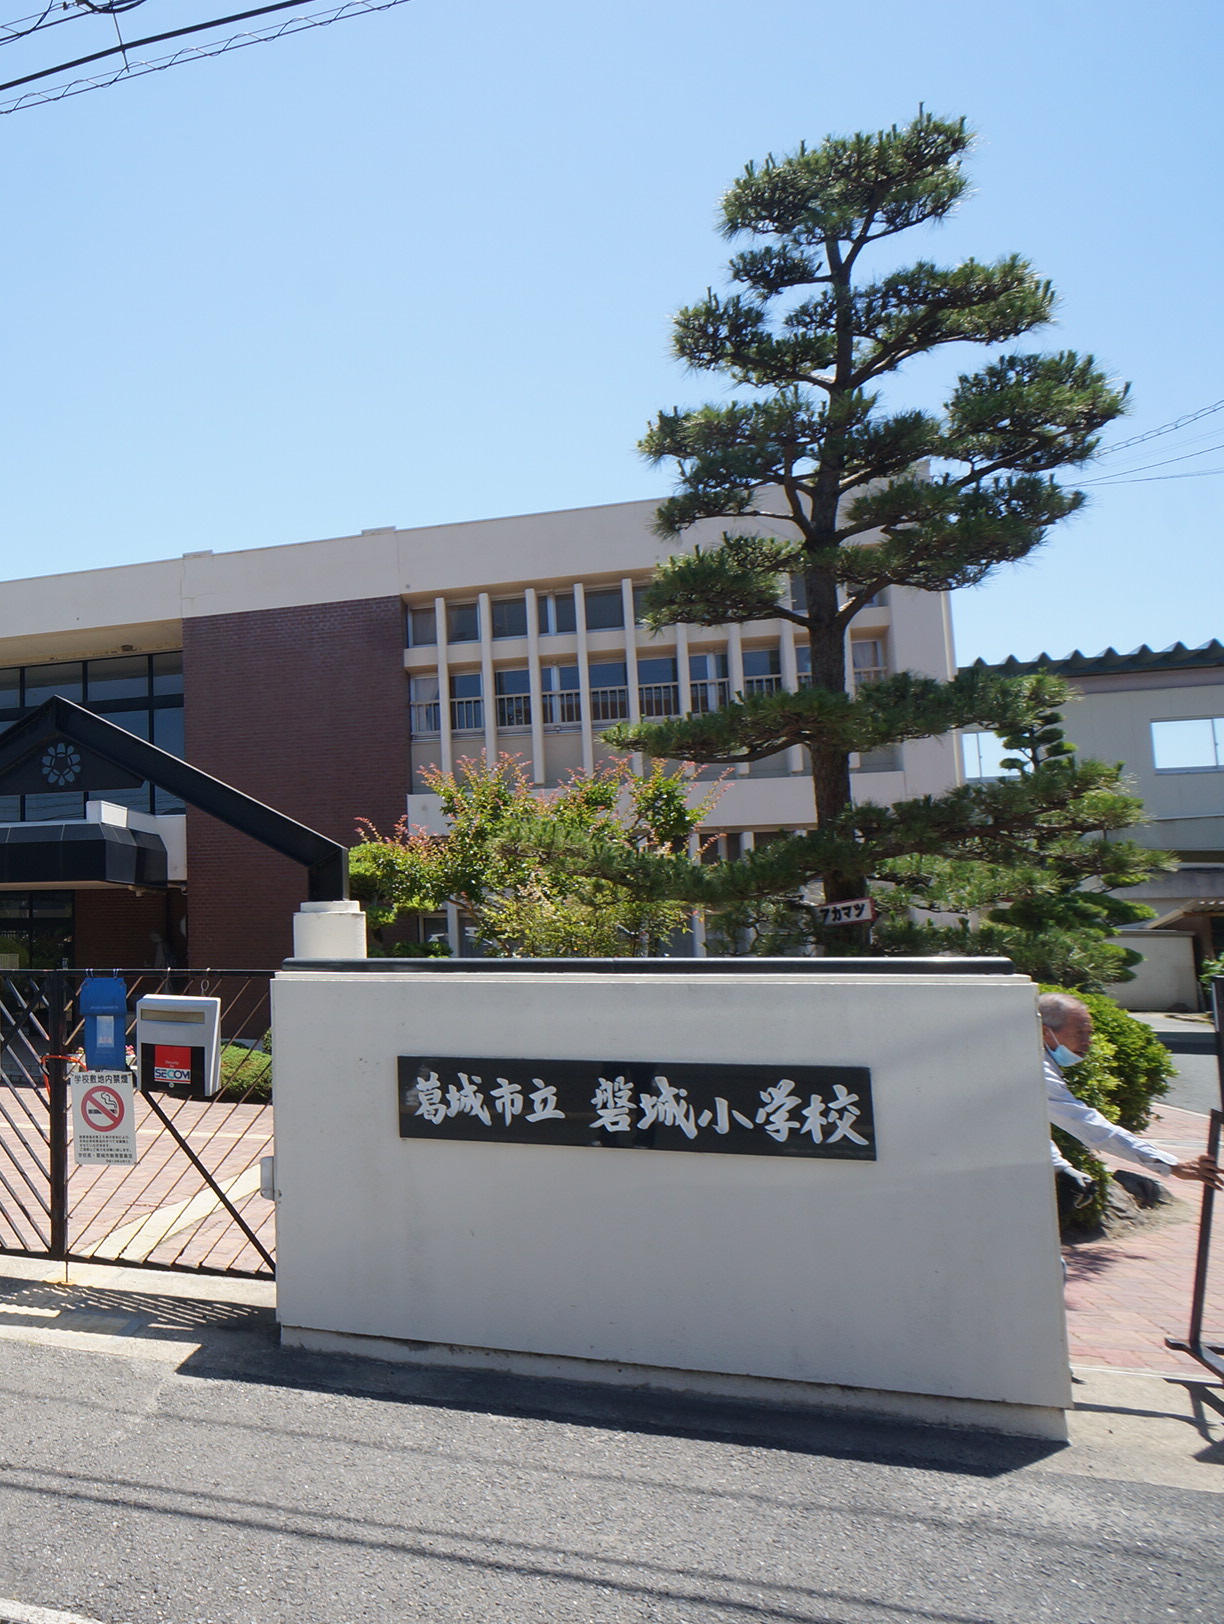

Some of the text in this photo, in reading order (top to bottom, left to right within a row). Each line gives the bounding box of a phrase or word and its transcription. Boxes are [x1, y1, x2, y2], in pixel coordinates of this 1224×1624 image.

[74, 1074, 129, 1084] 学校敷地内禁煙
[155, 1069, 190, 1080] SECOM
[413, 1071, 870, 1146] 葛城市立 磐城小学校
